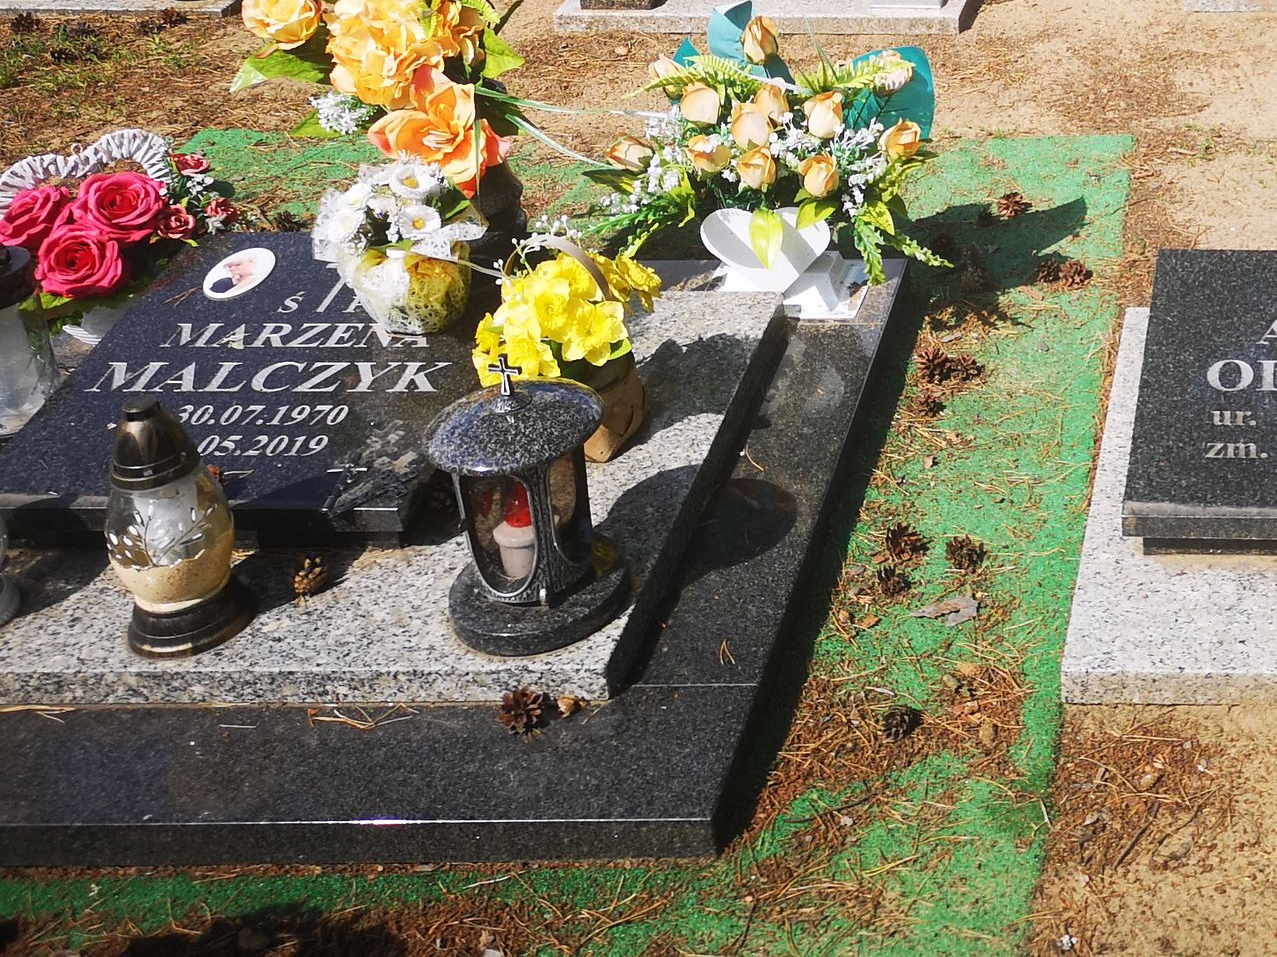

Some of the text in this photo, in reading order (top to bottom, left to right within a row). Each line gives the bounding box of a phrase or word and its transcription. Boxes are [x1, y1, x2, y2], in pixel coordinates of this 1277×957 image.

[87, 361, 453, 393] MALCZYK
[1210, 408, 1258, 427] ur.
[197, 435, 330, 456] 05.2019
[1204, 439, 1268, 460] zm.
